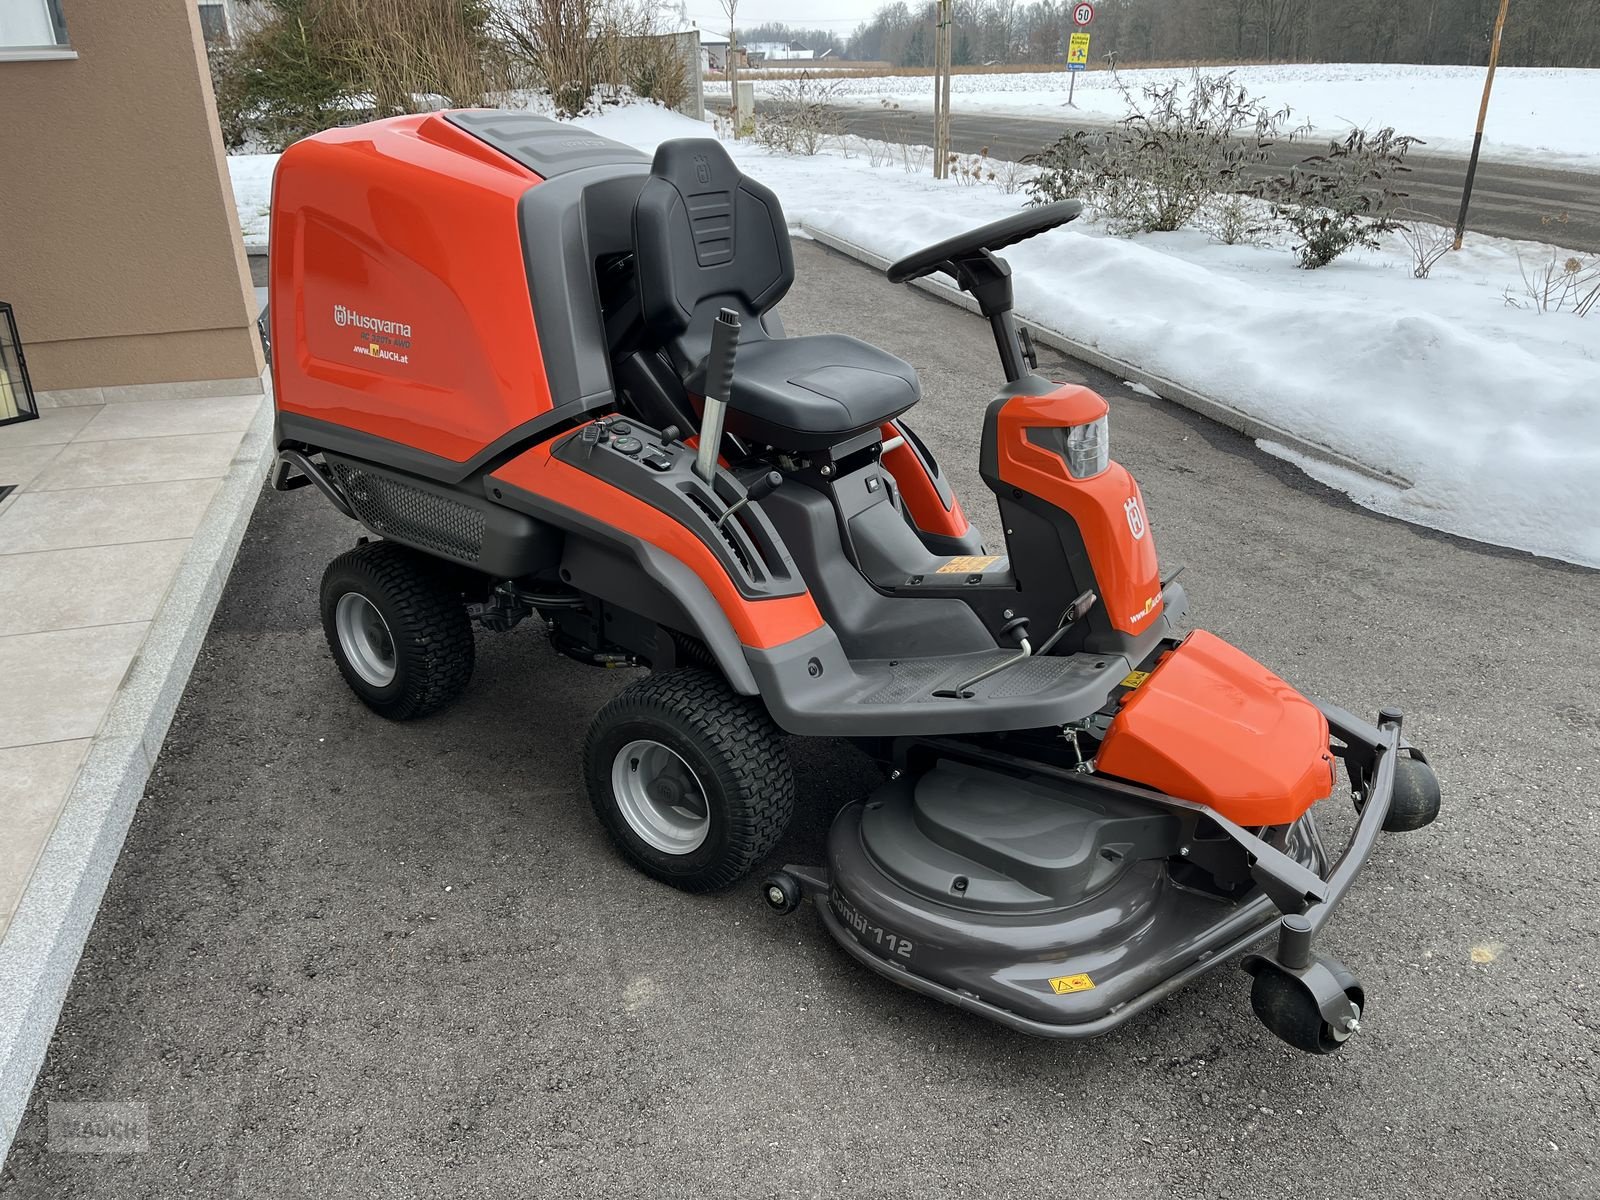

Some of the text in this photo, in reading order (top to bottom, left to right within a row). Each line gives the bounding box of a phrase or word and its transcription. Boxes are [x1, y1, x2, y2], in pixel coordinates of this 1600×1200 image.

[1078, 9, 1089, 21] 50
[347, 310, 411, 337] Husqvarna
[874, 928, 913, 958] 112
